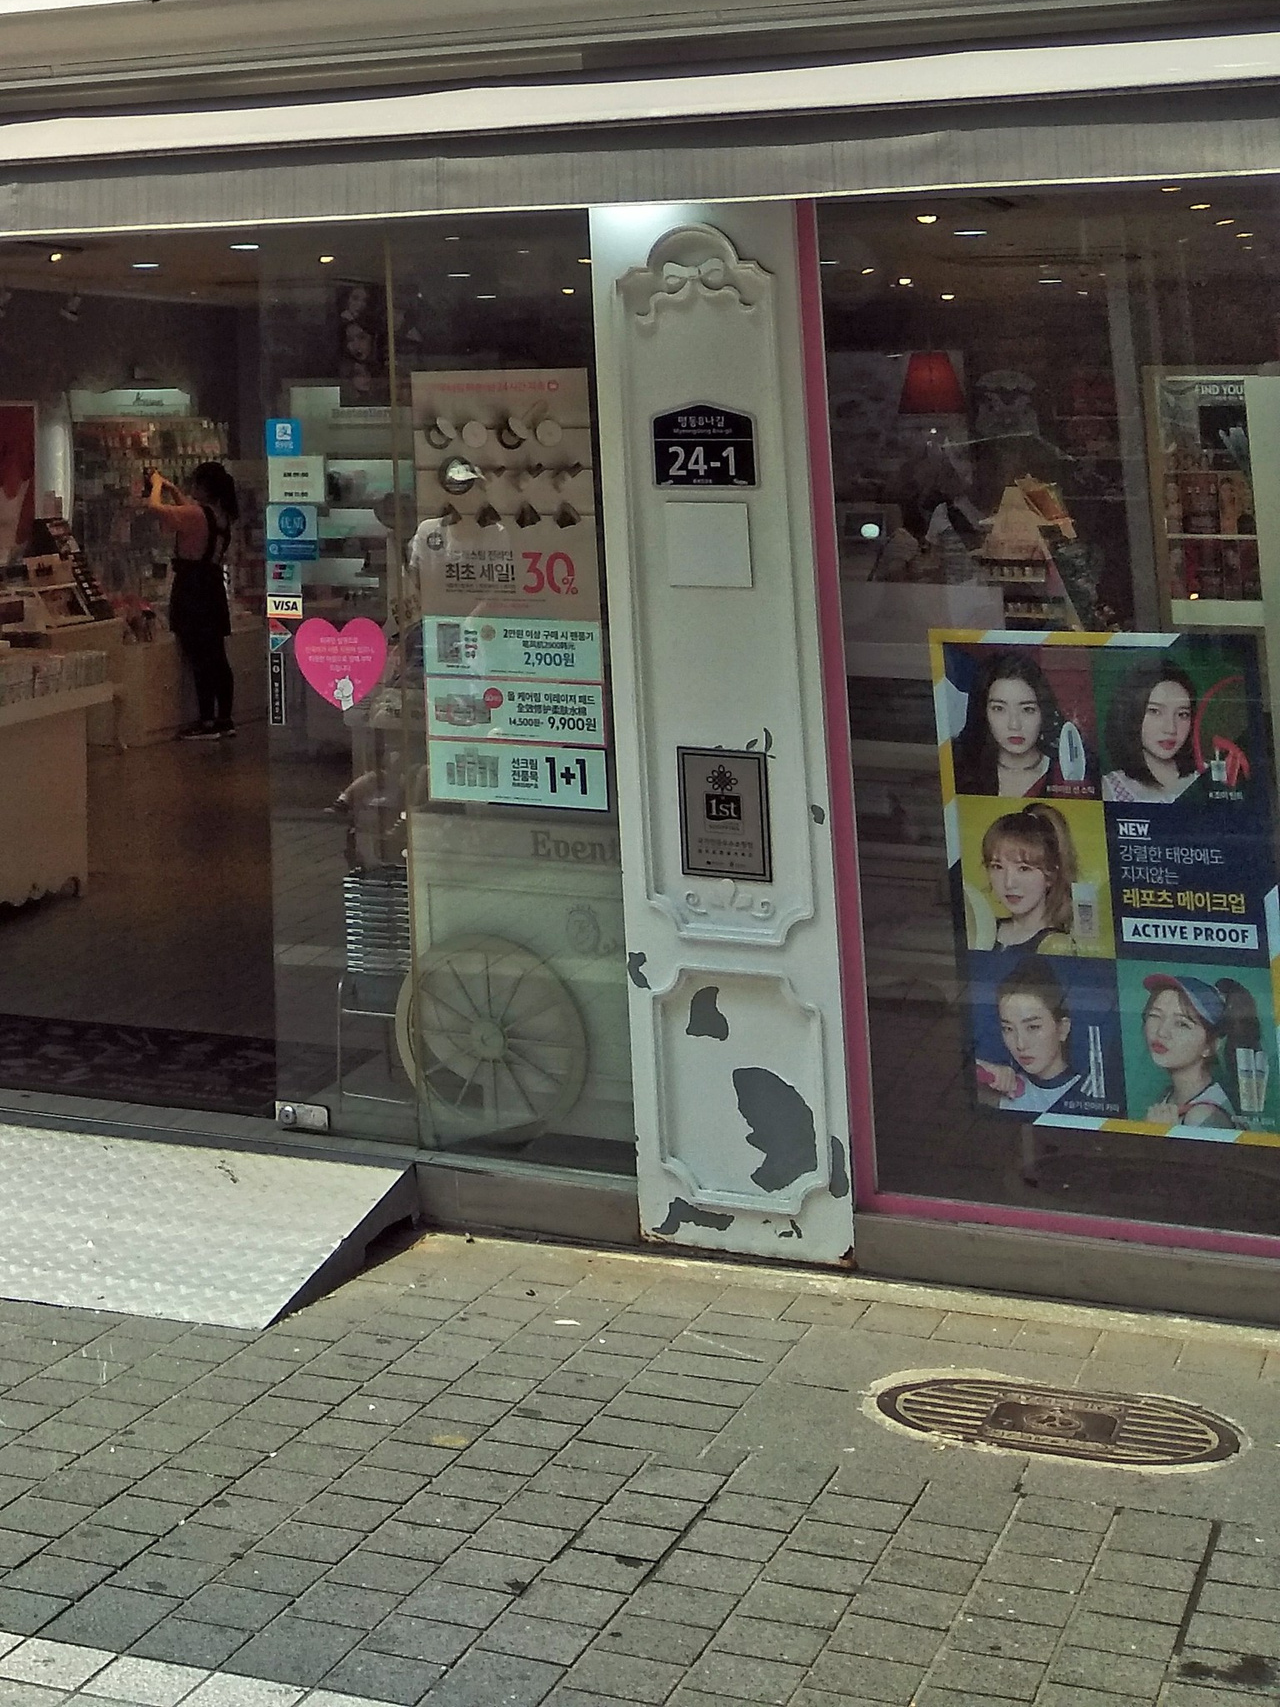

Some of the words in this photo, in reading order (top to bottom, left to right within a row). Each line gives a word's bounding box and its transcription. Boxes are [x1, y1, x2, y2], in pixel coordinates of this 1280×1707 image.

[677, 416, 725, 428] 명동8나길
[668, 446, 736, 476] 24-1
[445, 562, 476, 581] 최초
[479, 563, 515, 582] 세일!
[273, 600, 299, 612] VISA
[525, 630, 541, 640] 이상
[543, 630, 559, 641] 구매
[560, 631, 569, 641] 시
[523, 652, 576, 668] 2,900원
[547, 716, 597, 732] 9,900원
[511, 758, 538, 770] 선크림
[545, 757, 588, 795] 1+1
[709, 798, 739, 818] 1st
[1119, 822, 1150, 837] NEW
[1119, 845, 1163, 864] 강렬한
[1165, 847, 1225, 865] 태양에도
[1121, 866, 1180, 885] 지지않는
[1122, 888, 1175, 908] 레포츠
[1177, 890, 1246, 915] 메이크업
[1131, 923, 1189, 941] ACTIVE
[1193, 926, 1250, 944] PROOF
